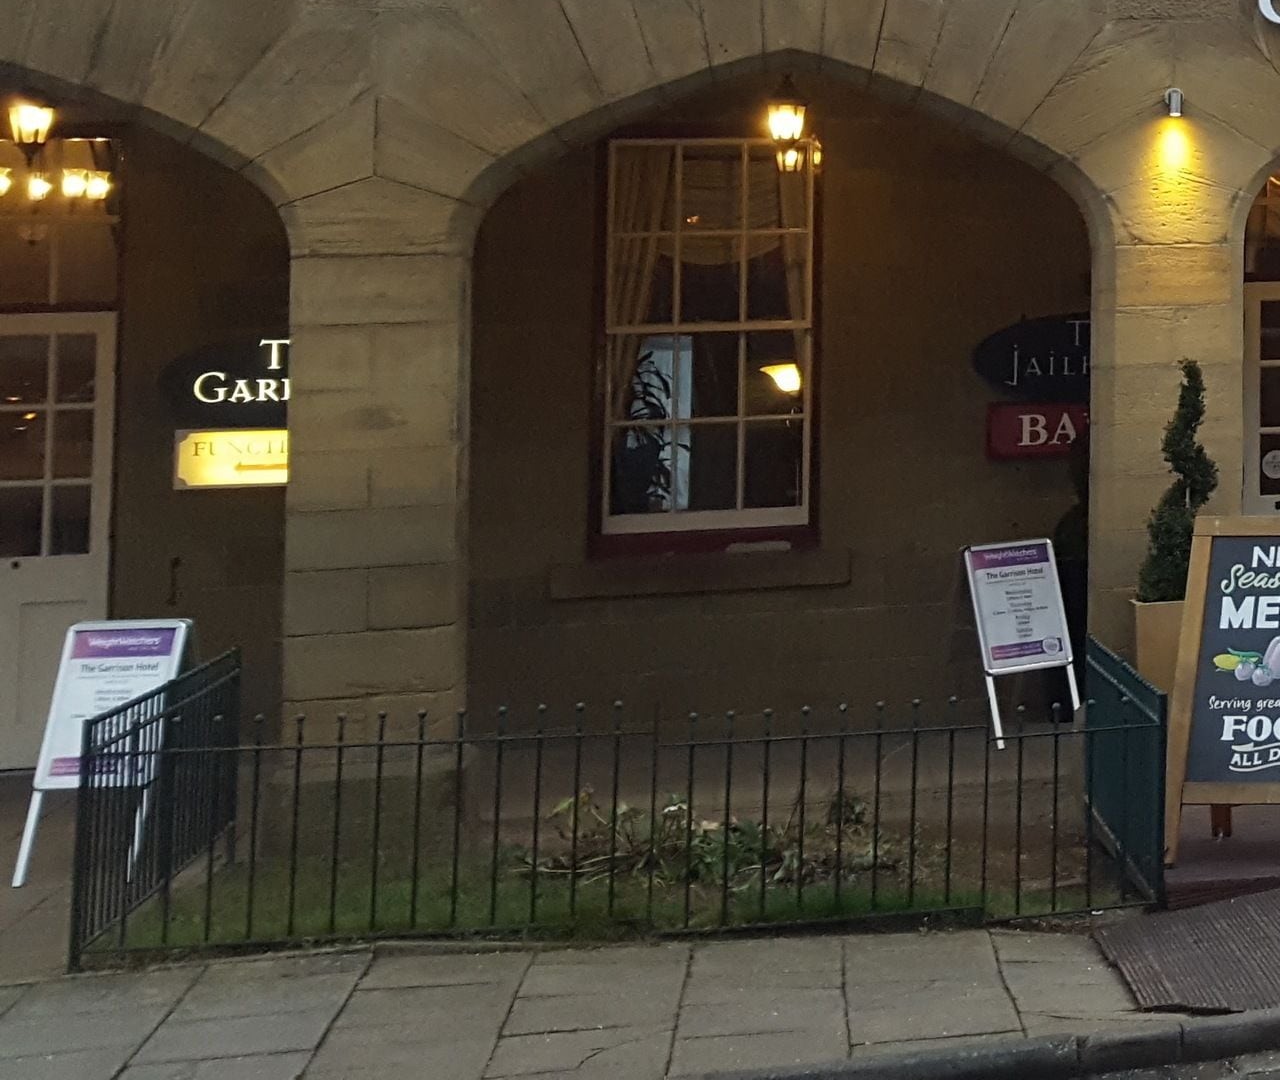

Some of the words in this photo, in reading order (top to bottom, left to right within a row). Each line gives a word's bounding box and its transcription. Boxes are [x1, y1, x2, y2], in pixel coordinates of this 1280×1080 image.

[81, 663, 97, 673] The
[98, 663, 134, 673] Garrison
[136, 661, 159, 671] Hotel
[1208, 695, 1252, 712] Serving
[1230, 752, 1262, 766] ALL
